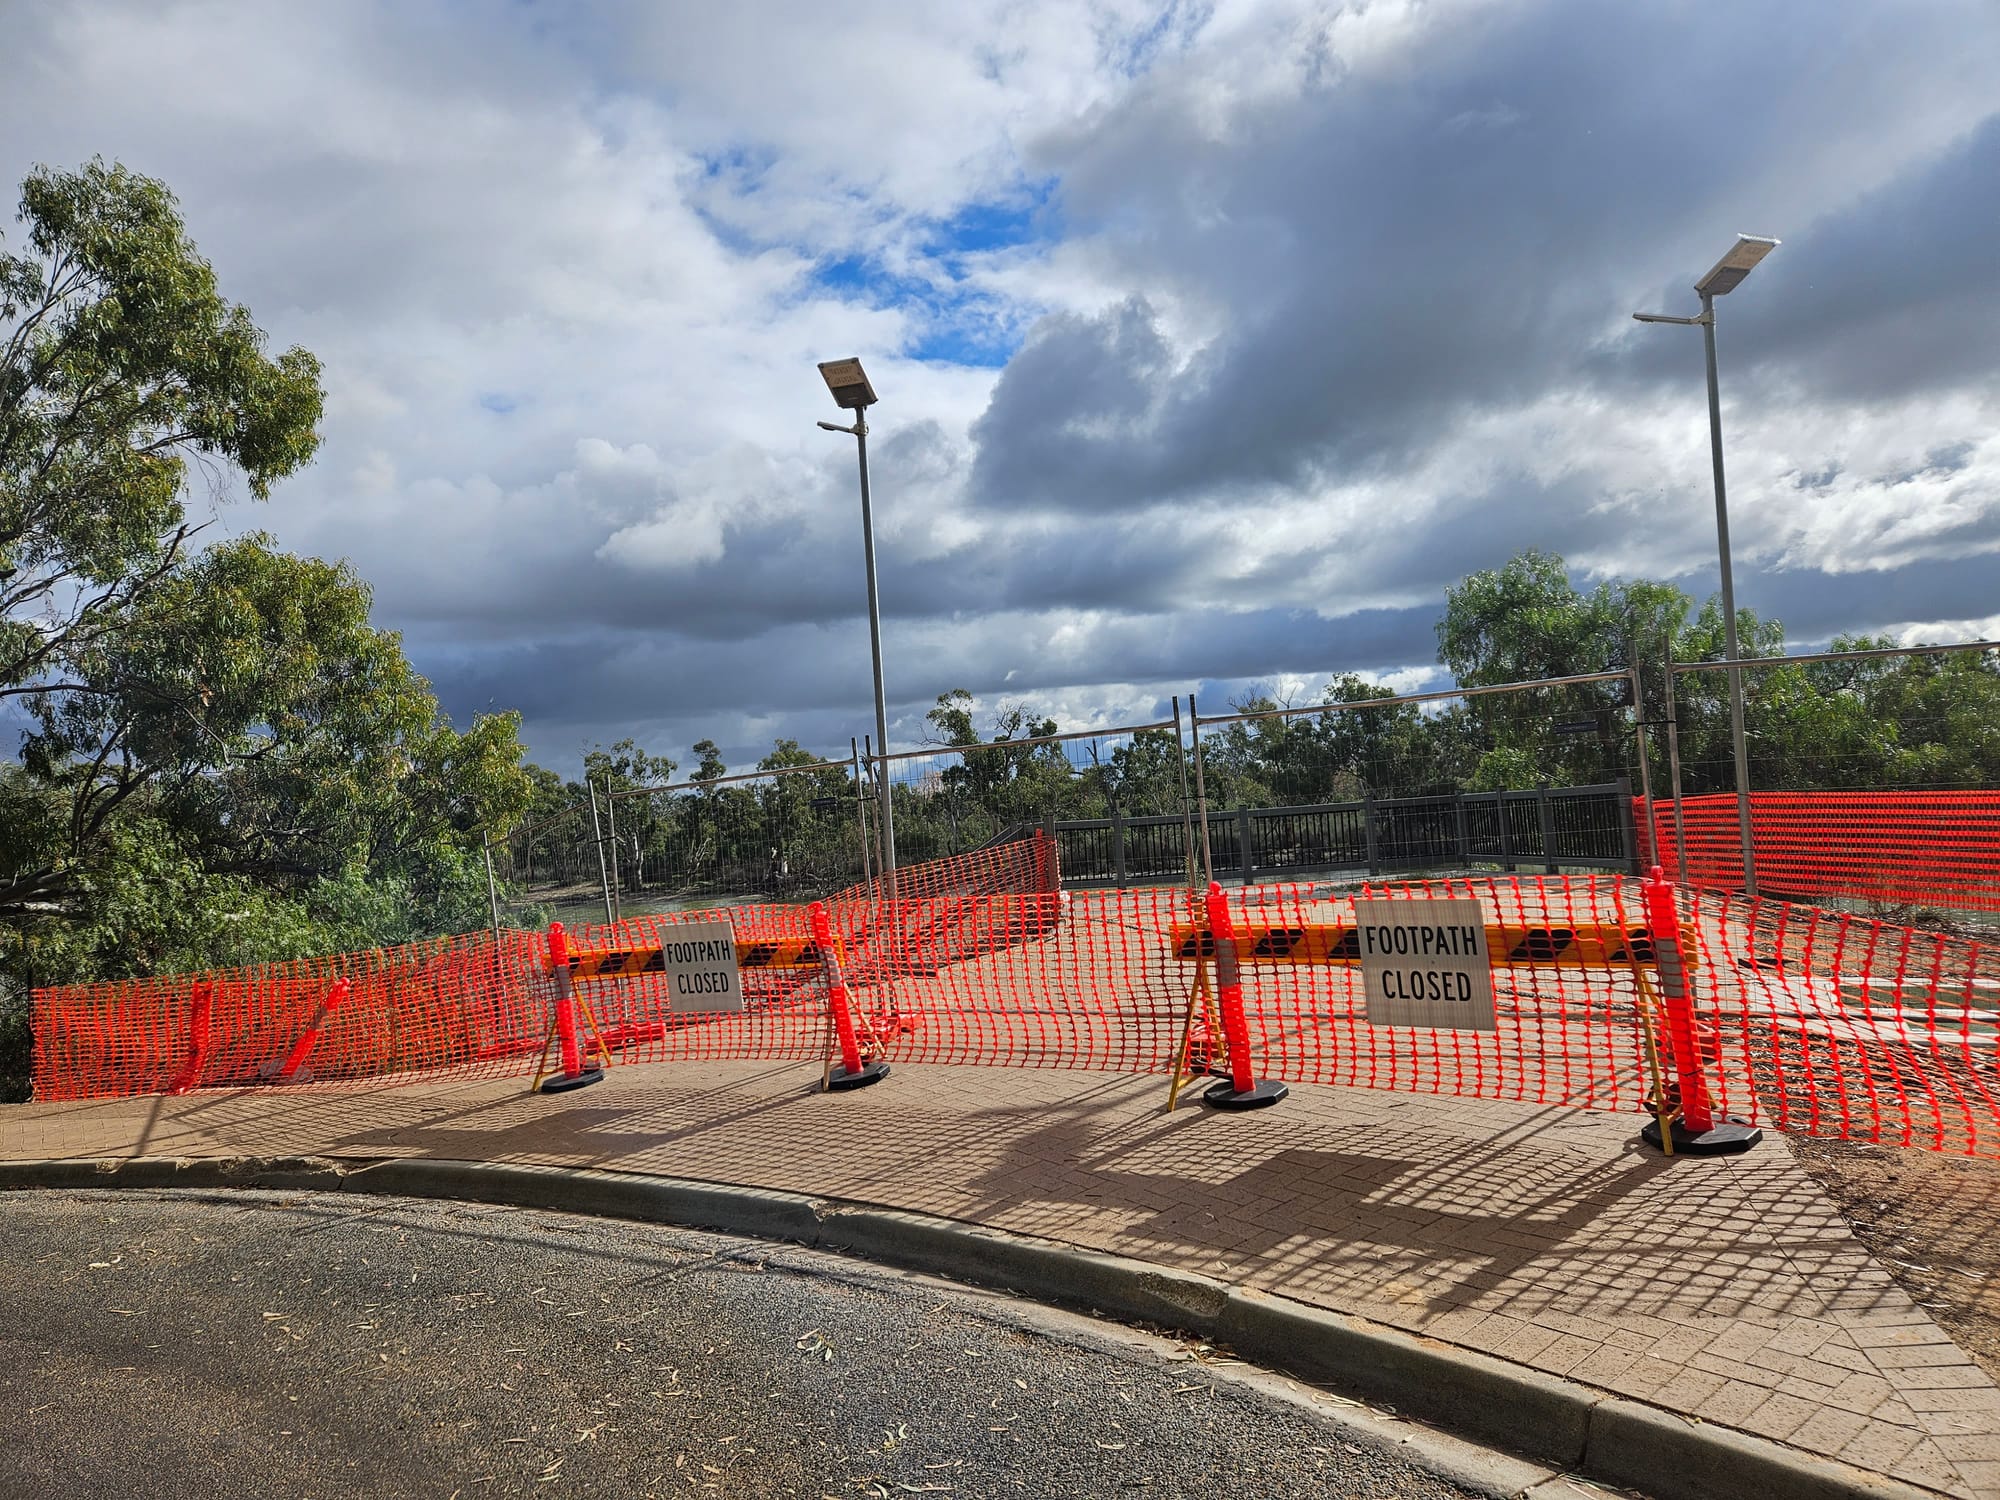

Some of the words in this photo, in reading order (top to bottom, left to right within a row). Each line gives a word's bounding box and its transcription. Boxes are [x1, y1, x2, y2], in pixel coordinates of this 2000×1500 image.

[666, 940, 731, 963] FOOTPATH
[1365, 925, 1478, 956] FOOTPATH
[677, 972, 729, 994] CLOSED
[1381, 969, 1472, 1002] CLOSED
